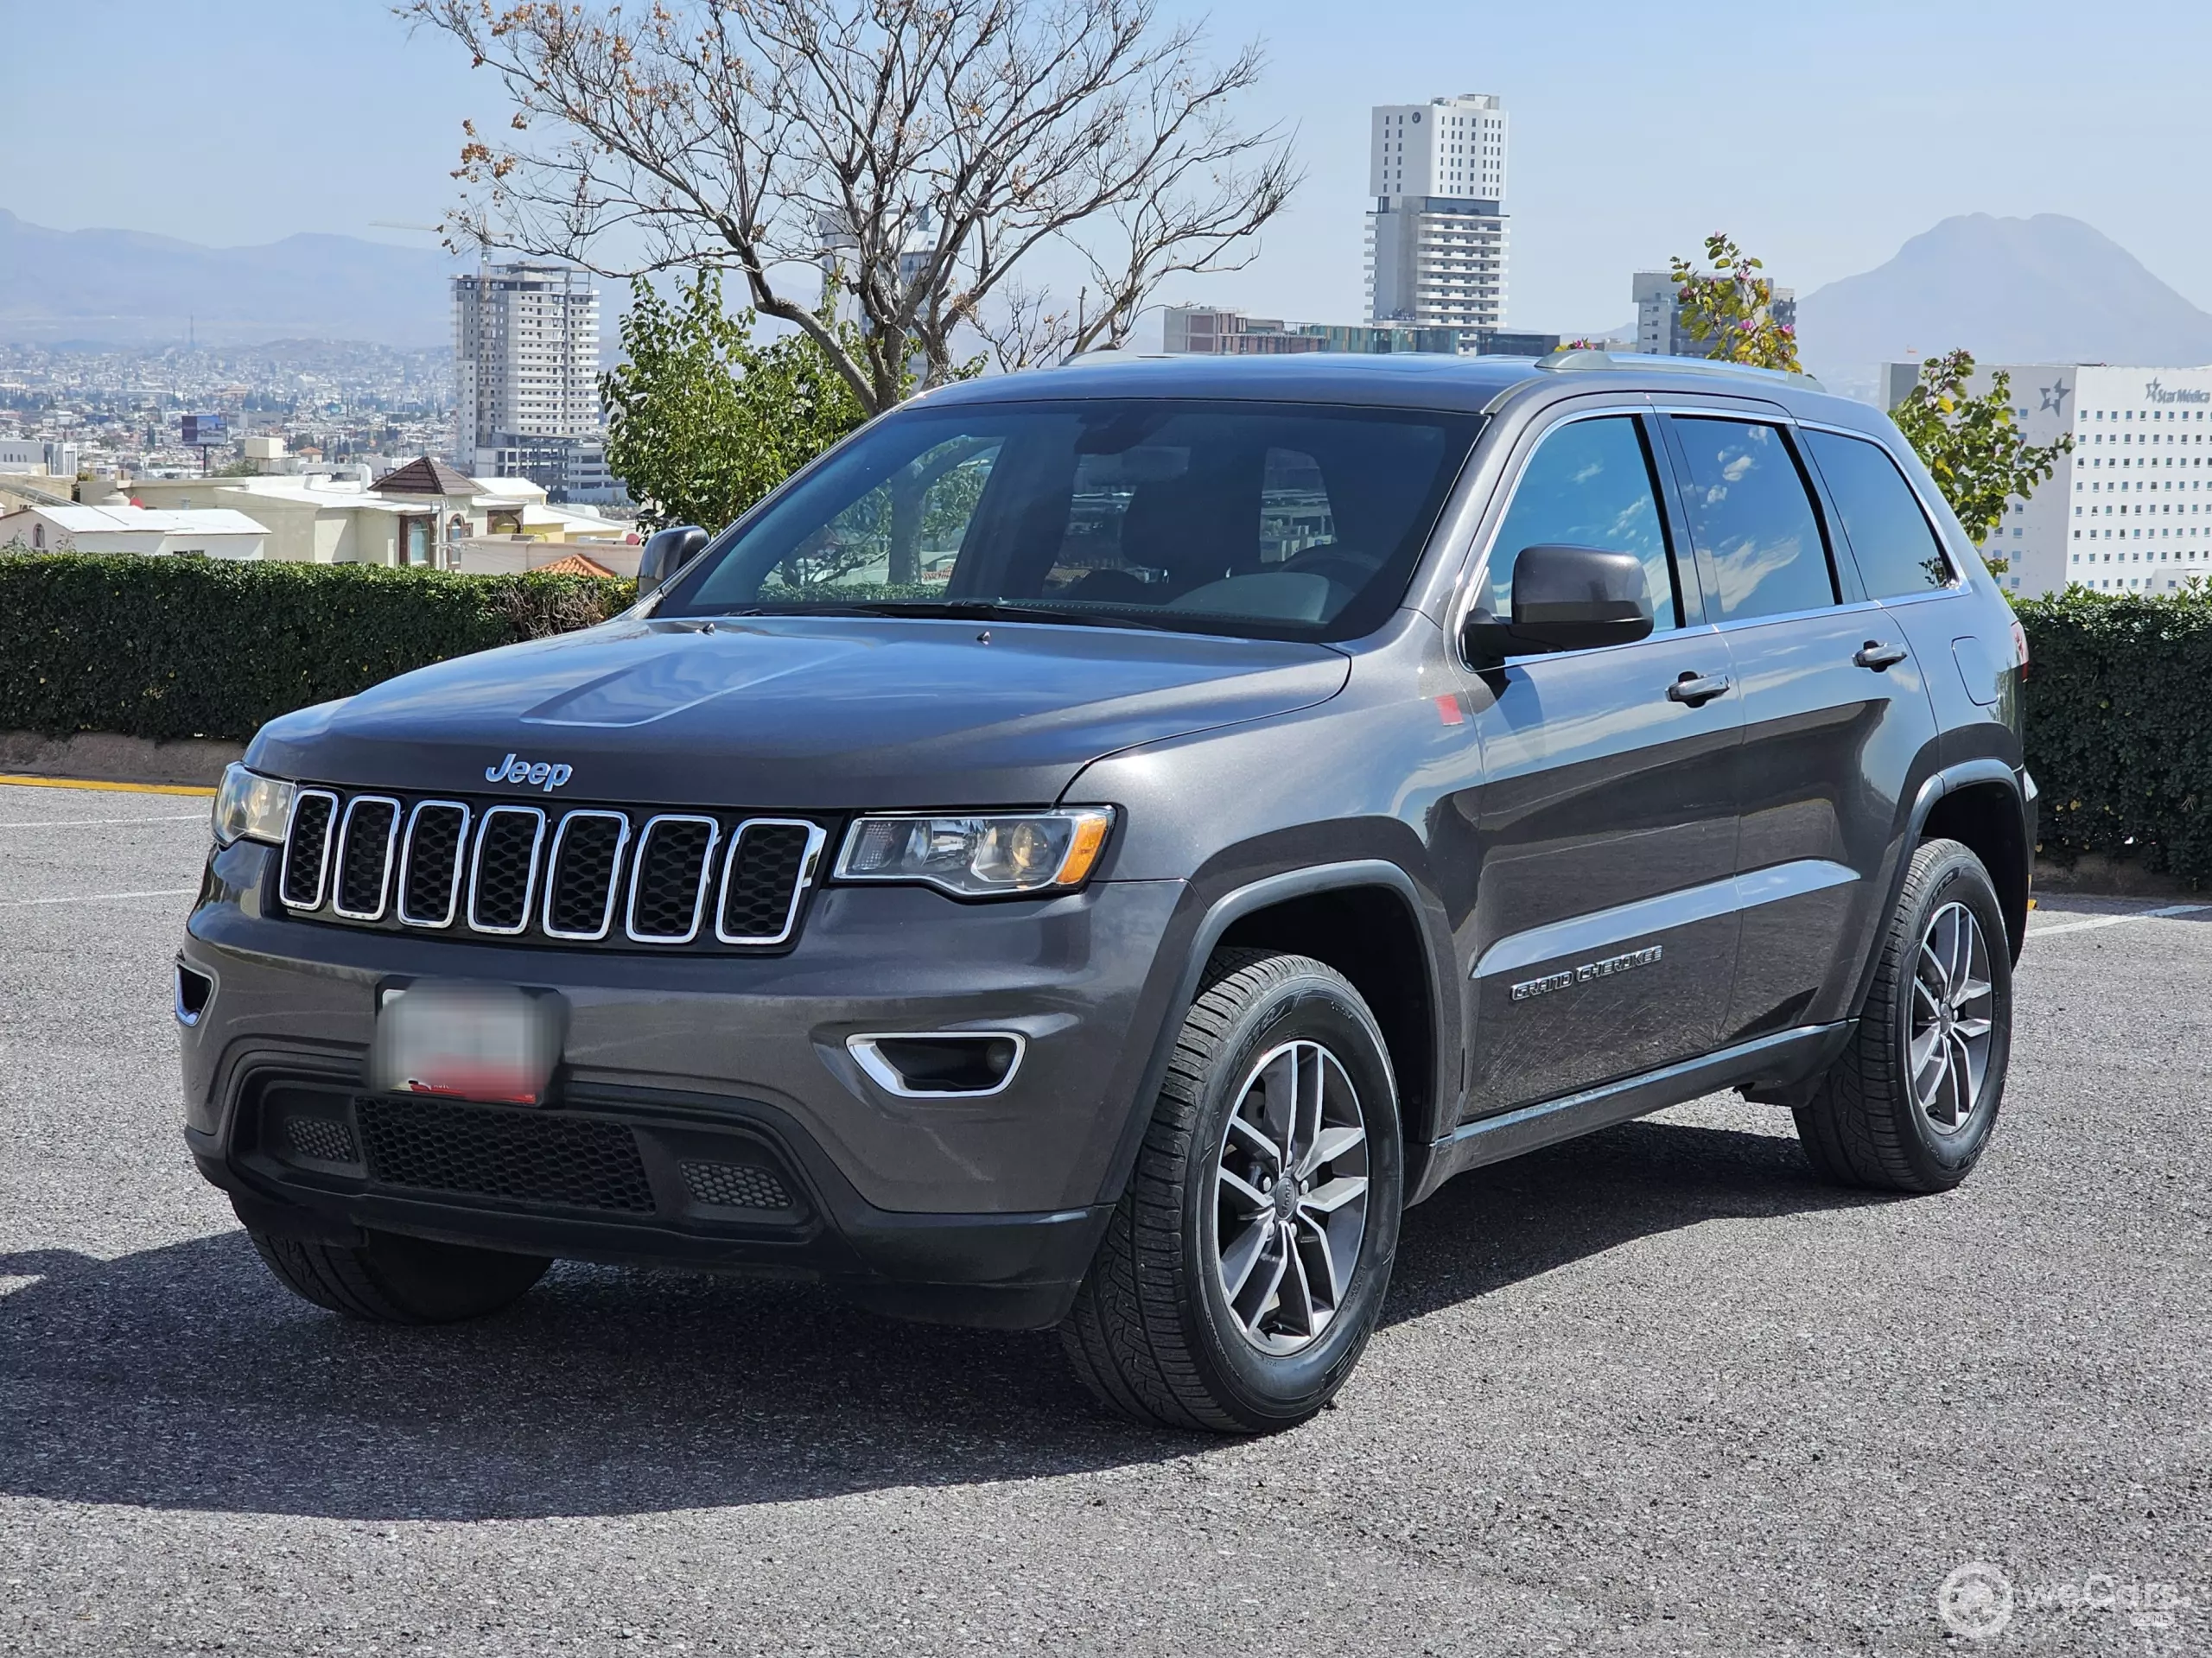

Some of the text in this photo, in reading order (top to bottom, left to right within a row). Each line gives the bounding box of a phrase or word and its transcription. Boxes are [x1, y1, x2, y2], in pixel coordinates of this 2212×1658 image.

[486, 753, 573, 792] Jeep
[1511, 945, 1662, 1001] GRAND CHEROKEE
